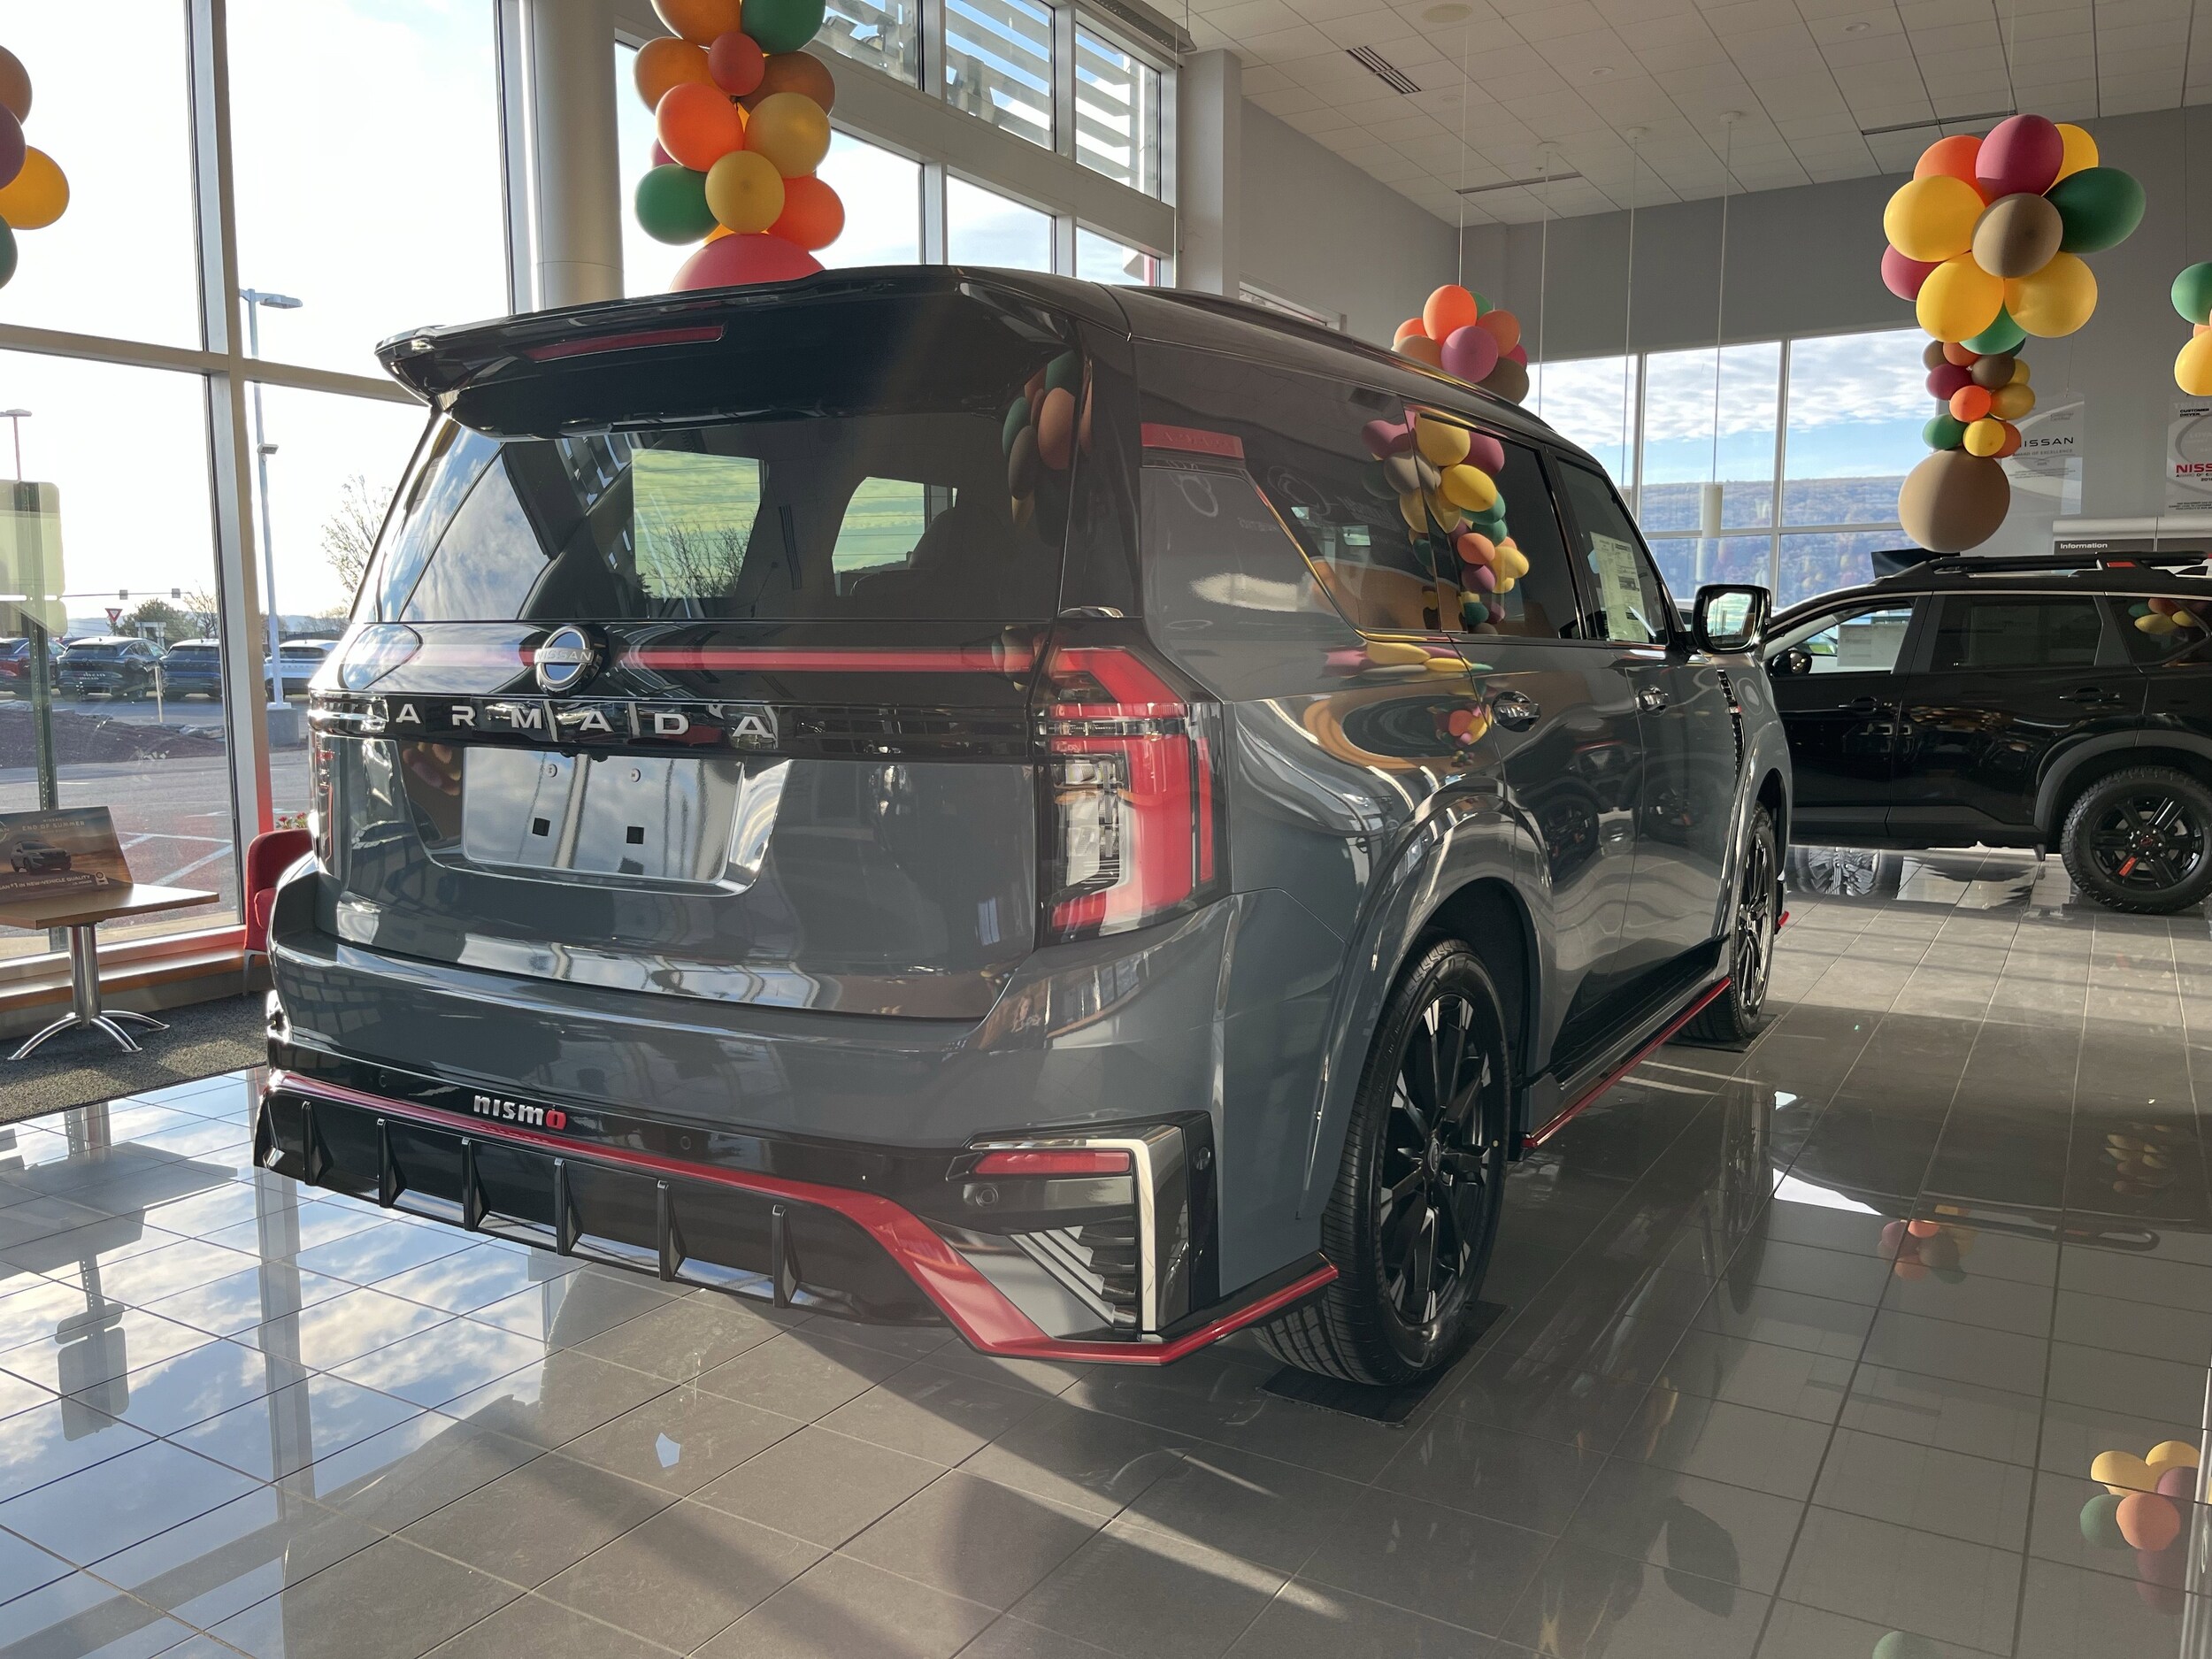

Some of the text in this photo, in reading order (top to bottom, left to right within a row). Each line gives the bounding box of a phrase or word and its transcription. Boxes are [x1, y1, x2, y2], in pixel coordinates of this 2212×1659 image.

[2019, 437, 2074, 448] ISSAN
[536, 649, 592, 661] NISSAN
[396, 703, 776, 740] ARMADA
[473, 1094, 567, 1131] nismo
